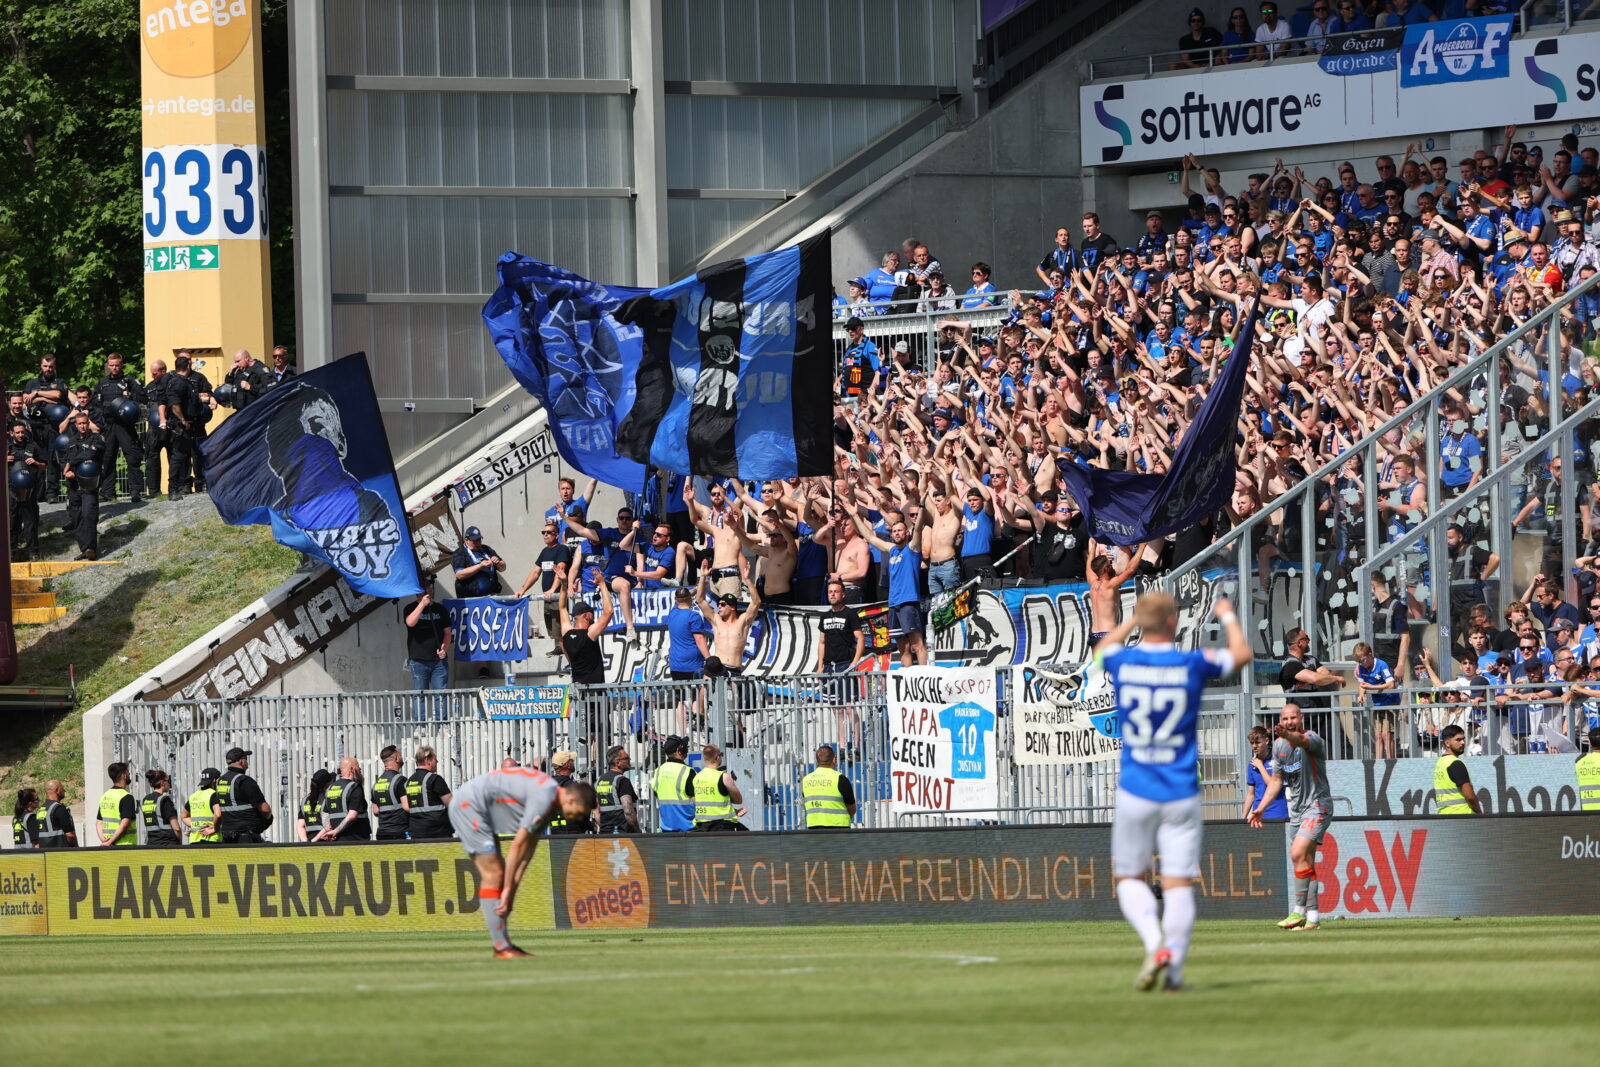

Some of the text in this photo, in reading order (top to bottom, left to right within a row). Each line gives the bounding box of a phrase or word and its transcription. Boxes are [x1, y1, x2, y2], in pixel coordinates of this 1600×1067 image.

[145, 0, 247, 38] entega
[1458, 26, 1468, 38] SC
[1342, 37, 1385, 52] Gegen
[1410, 22, 1510, 76] A F
[1434, 39, 1476, 54] PADERBORN
[1326, 53, 1386, 73] g(e)rade
[1453, 58, 1463, 70] 07
[1577, 62, 1600, 102] s
[157, 95, 256, 117] entega.de
[1141, 91, 1321, 144] software AG
[465, 474, 487, 498] PB
[492, 457, 514, 482] SC
[514, 434, 547, 470] 1907
[484, 687, 564, 701] SCHNAPS & WEED
[892, 675, 946, 704] TAUSCHE
[902, 707, 938, 737] PAPA
[1120, 684, 1188, 747] 32
[892, 737, 935, 768] GEGEN
[958, 724, 978, 755] 10
[1026, 732, 1051, 756] DEIN
[1055, 728, 1097, 758] TRIKOT
[893, 771, 954, 811] TRIKOT
[666, 860, 791, 905] EINFACH
[804, 855, 1095, 903] KLIMAFREUNDLICH
[574, 879, 645, 924] entega
